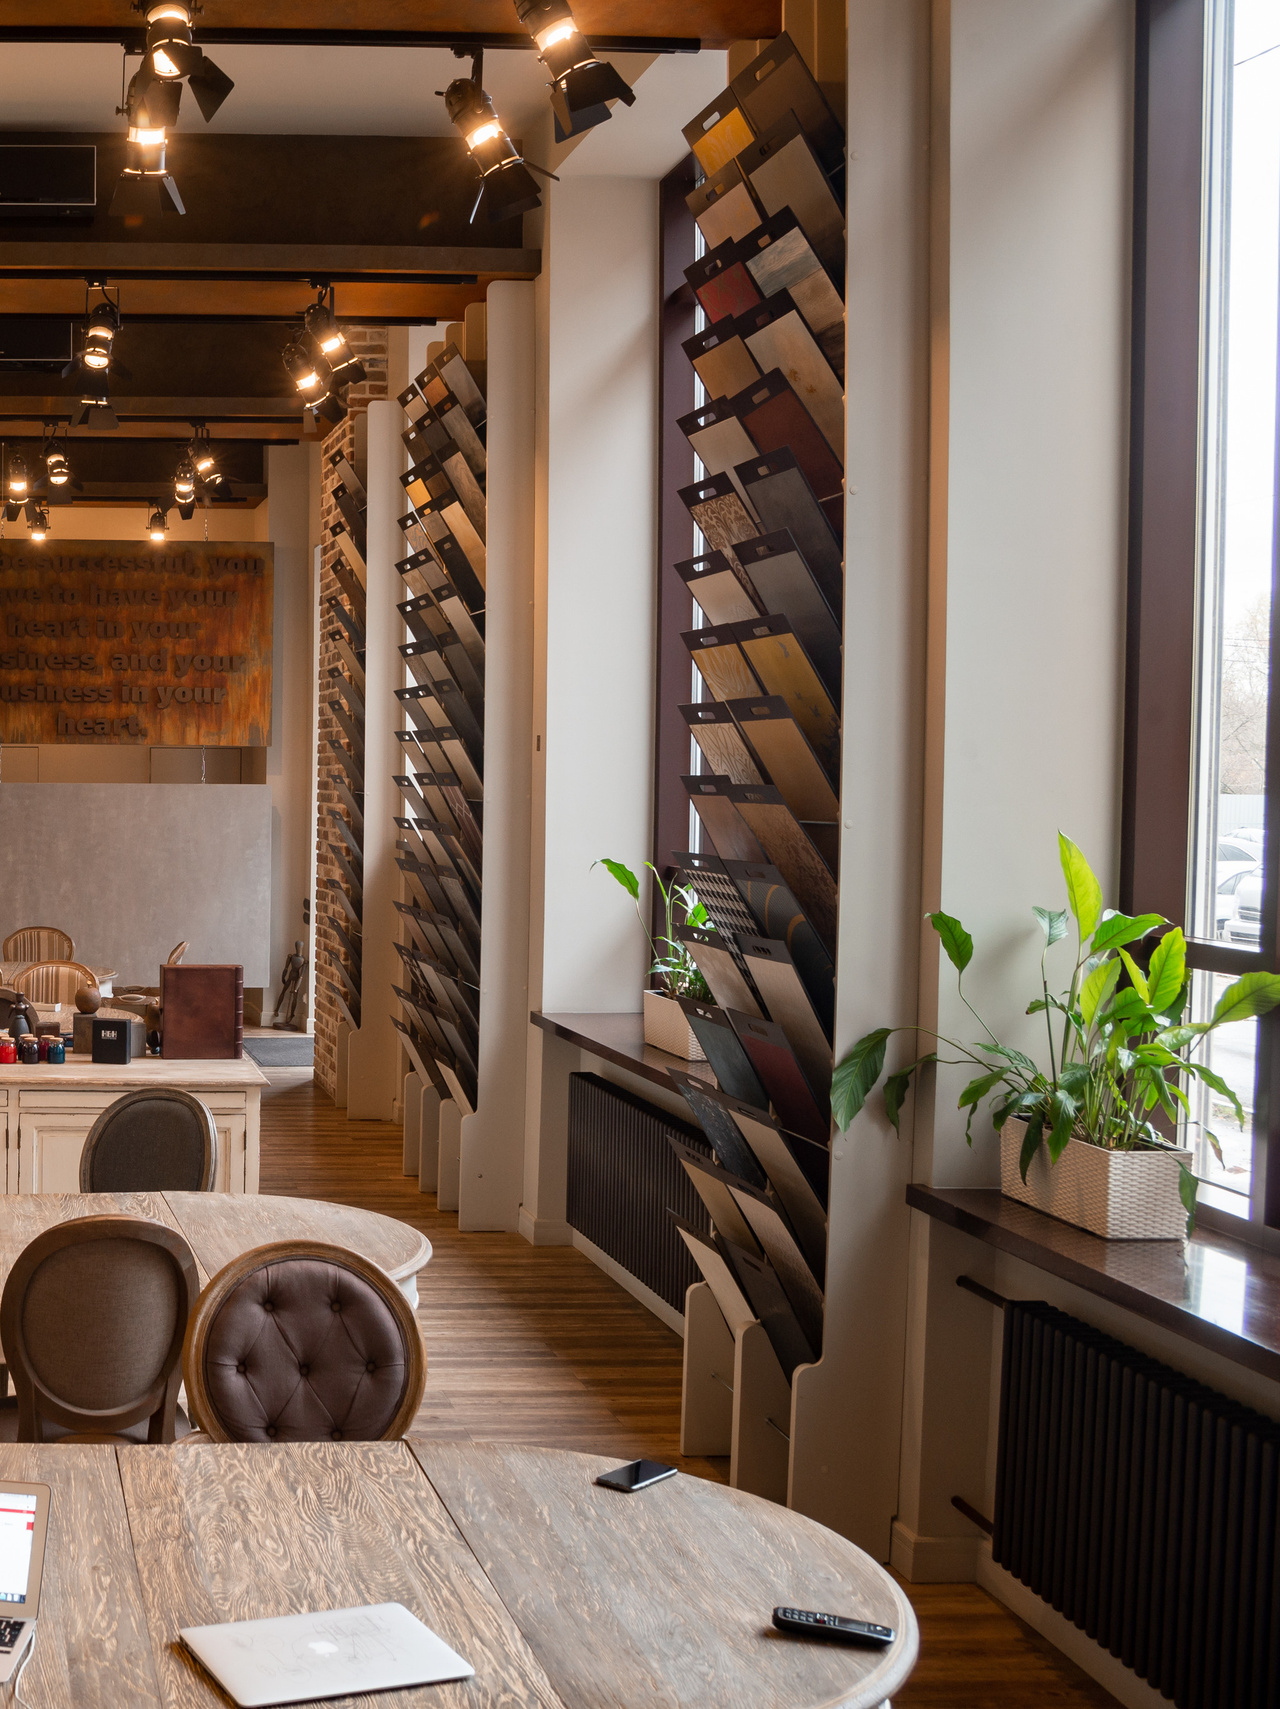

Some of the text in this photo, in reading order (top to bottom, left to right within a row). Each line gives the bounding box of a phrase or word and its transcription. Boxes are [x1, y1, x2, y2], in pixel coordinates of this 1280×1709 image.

[34, 550, 201, 578] successful,
[208, 556, 265, 580] you
[50, 583, 82, 604] to
[89, 584, 161, 606] have
[166, 590, 239, 612] your
[6, 614, 201, 644] heart in your
[112, 649, 167, 671] and
[174, 653, 246, 677] your
[121, 681, 149, 703] in
[156, 685, 227, 709] your
[56, 712, 148, 738] heart.
